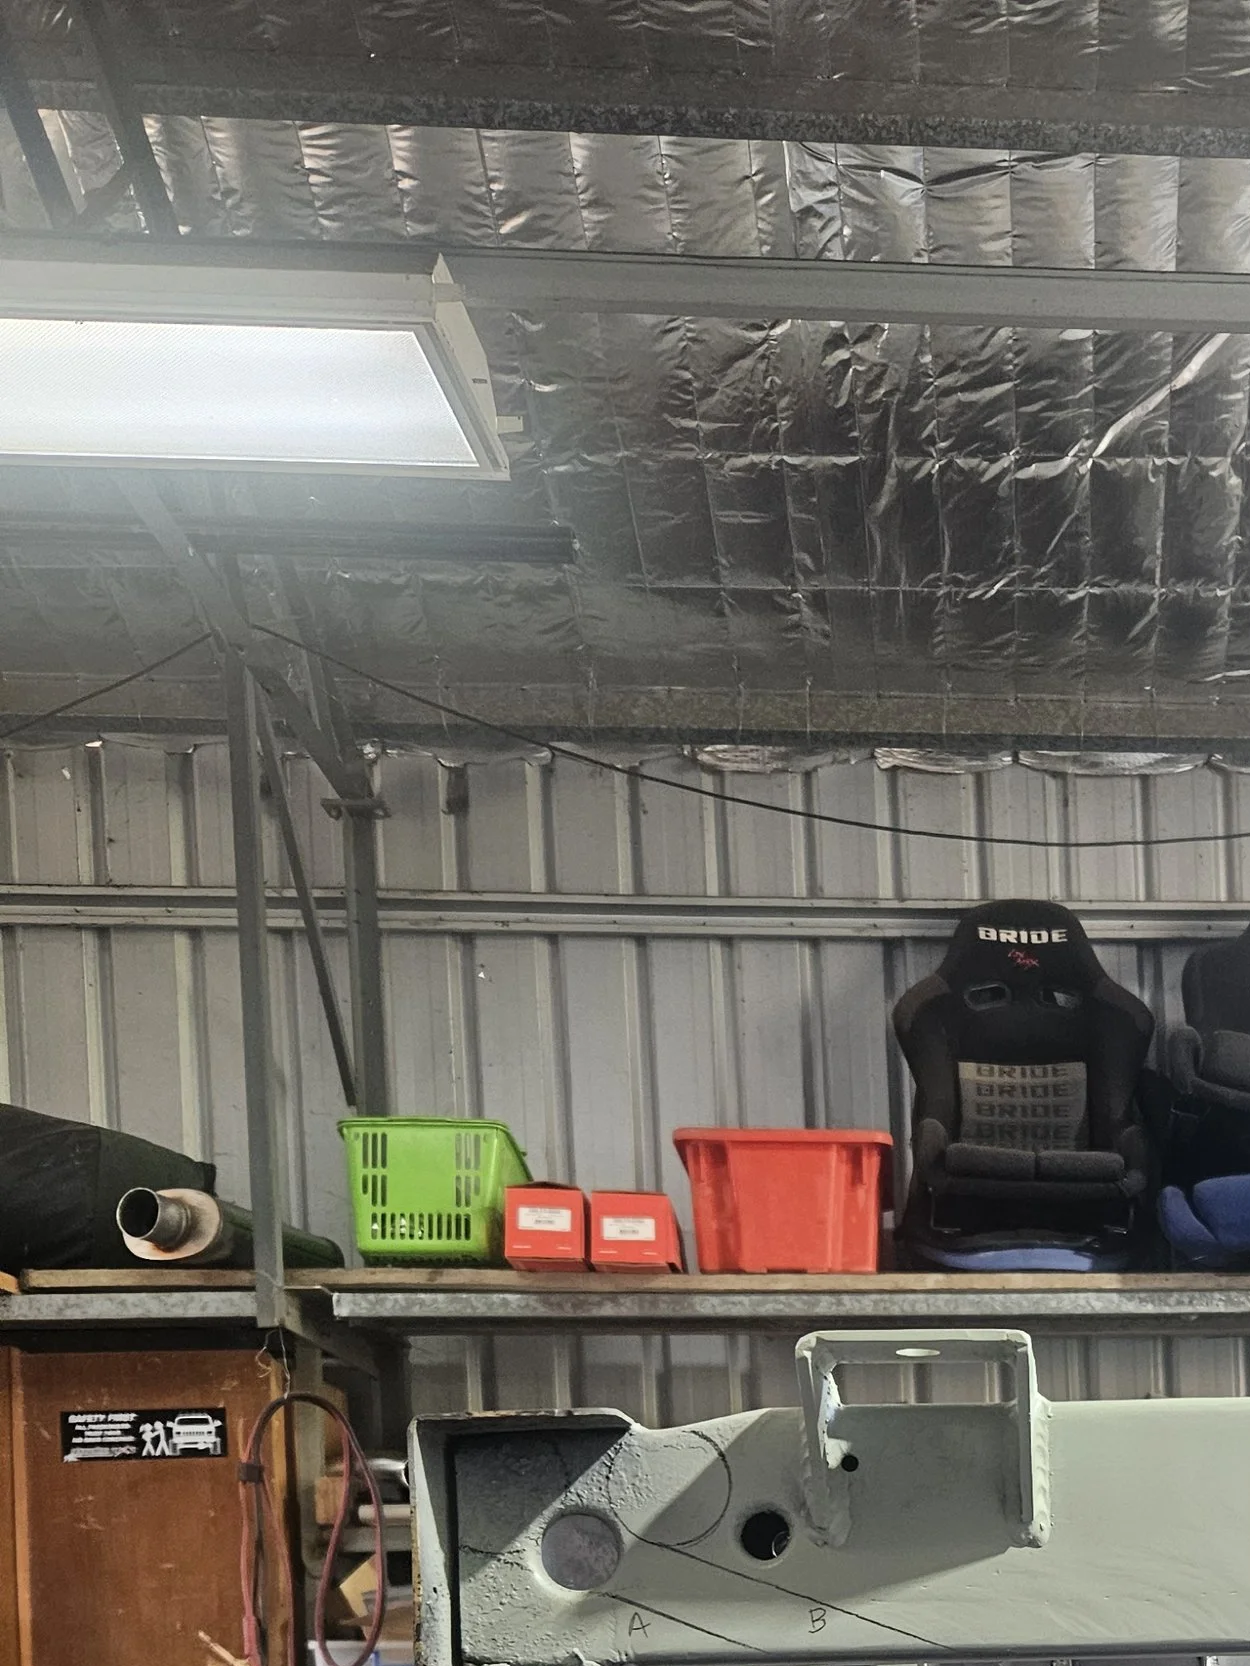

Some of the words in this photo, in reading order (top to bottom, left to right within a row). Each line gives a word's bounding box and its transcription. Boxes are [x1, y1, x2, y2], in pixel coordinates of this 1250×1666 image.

[977, 926, 1068, 944] BRIDE
[976, 1065, 1069, 1079] BRIDE
[976, 1082, 1070, 1098] BRIDE
[976, 1102, 1071, 1118] BRIDE
[628, 1611, 652, 1639] A
[808, 1606, 827, 1634] B
